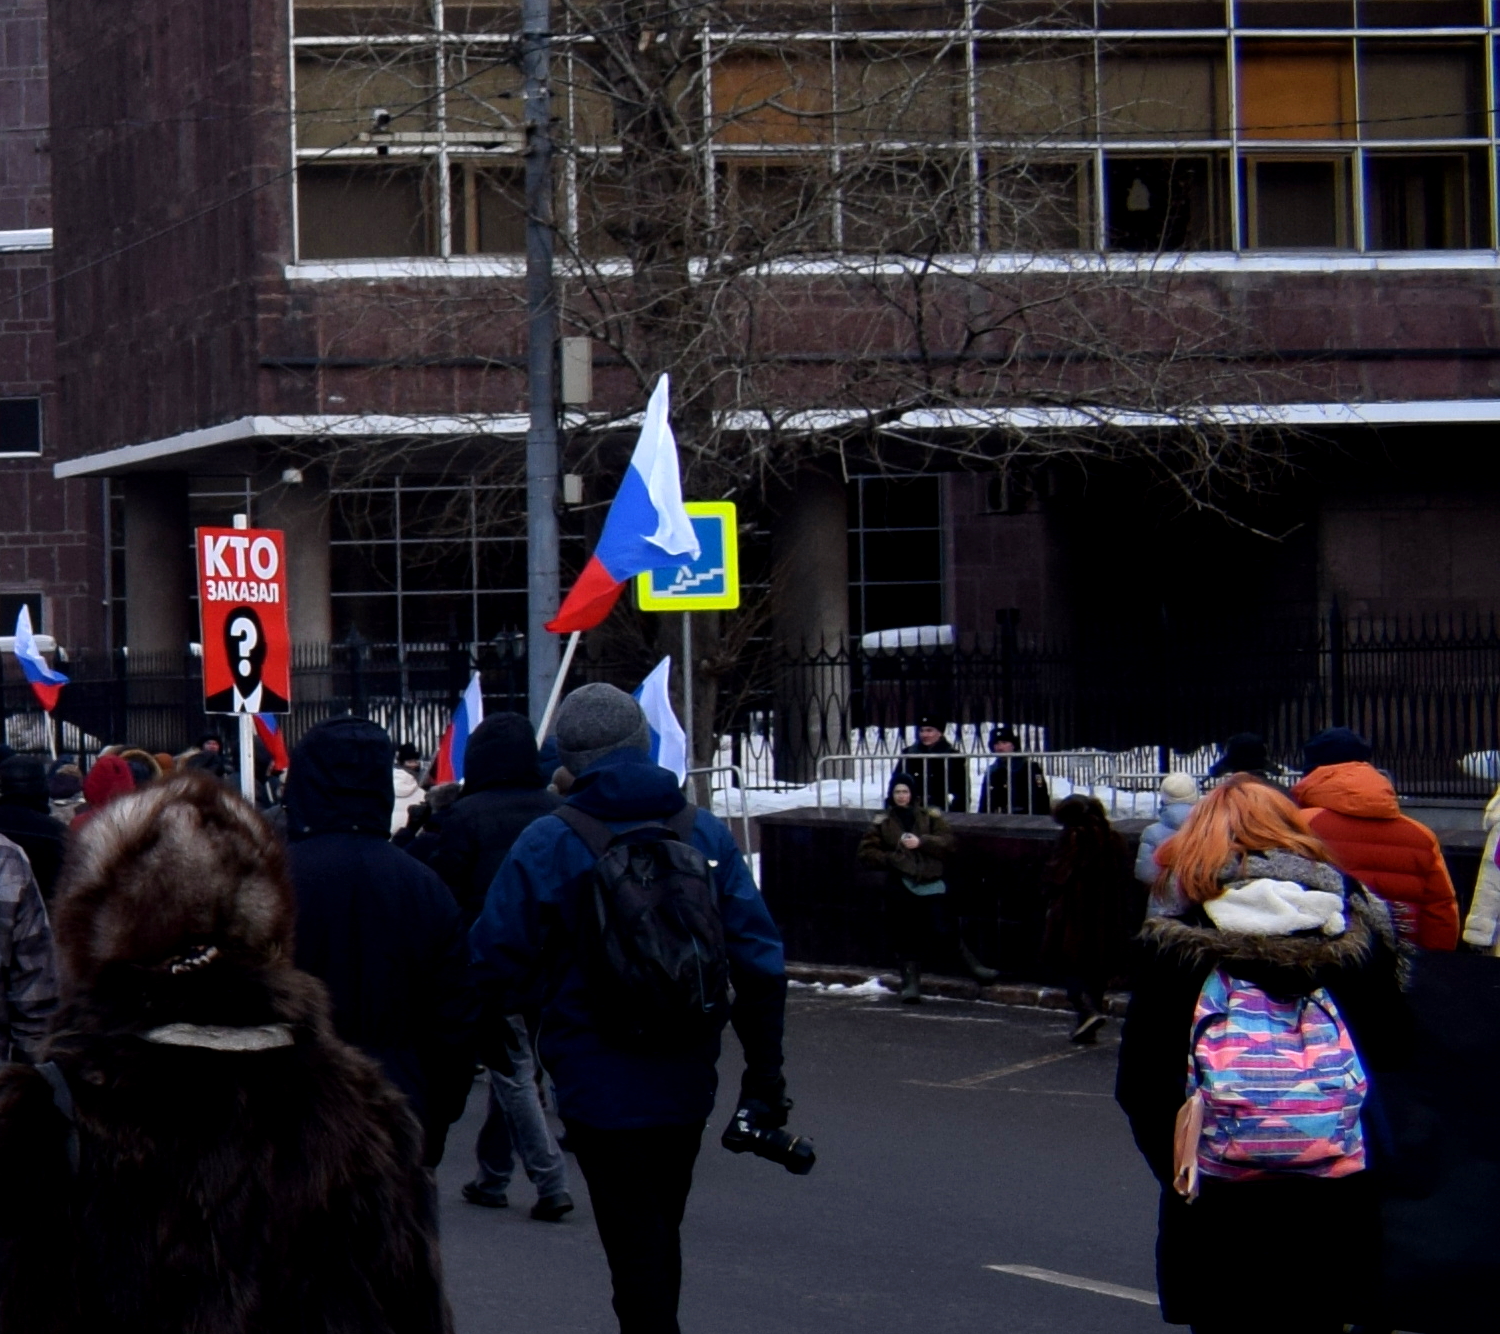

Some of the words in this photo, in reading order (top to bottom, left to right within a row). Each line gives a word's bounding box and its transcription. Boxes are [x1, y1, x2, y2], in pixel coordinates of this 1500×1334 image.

[203, 535, 279, 580] КТО
[206, 580, 280, 603] ЗАКАЗАЛ
[230, 617, 258, 677] ?
